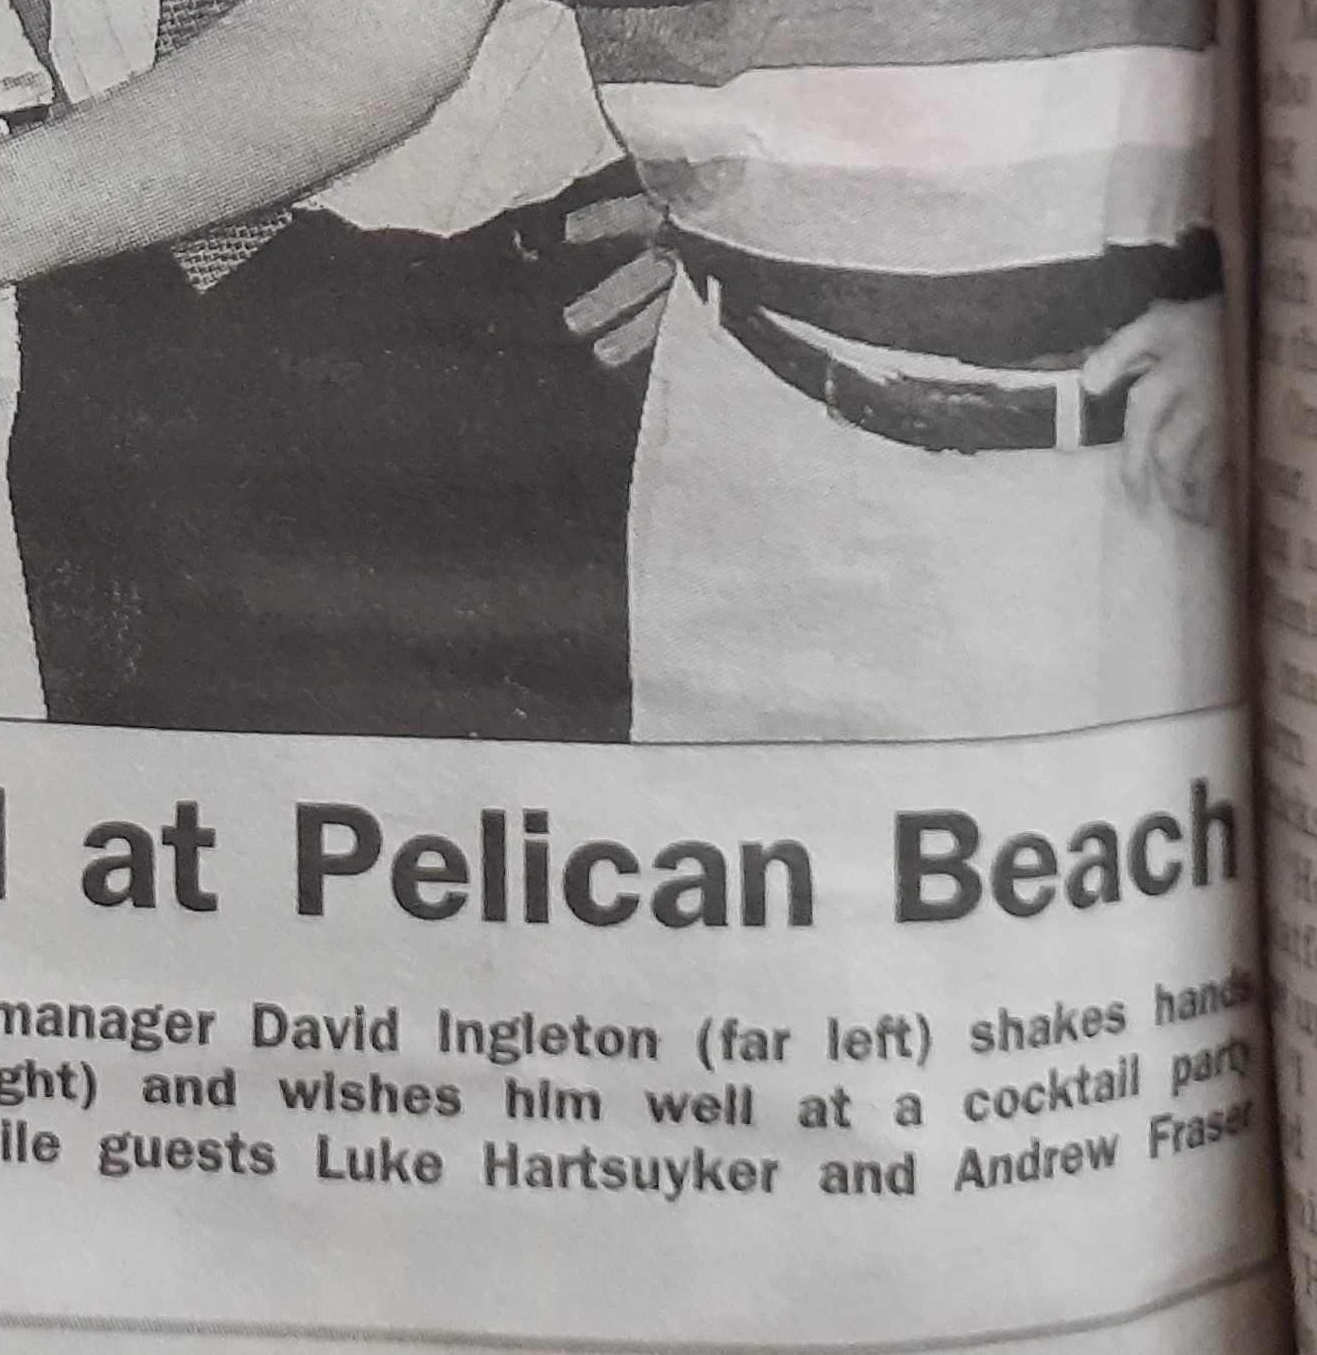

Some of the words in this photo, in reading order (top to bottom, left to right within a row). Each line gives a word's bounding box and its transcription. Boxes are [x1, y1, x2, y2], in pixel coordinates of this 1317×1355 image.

[81, 801, 219, 913] at
[295, 802, 814, 930] Pelican
[894, 779, 1238, 925] Beach
[252, 1002, 399, 1053] David
[439, 1009, 657, 1066] Ingleton
[696, 1018, 791, 1074] (far
[827, 1013, 933, 1068] left)
[971, 1001, 1127, 1055] shakes
[142, 1067, 236, 1108] and
[278, 1071, 461, 1117] wishes
[505, 1077, 601, 1121] him
[645, 1084, 752, 1126] well
[799, 1087, 852, 1129] at
[895, 1093, 923, 1127] a
[964, 1053, 1139, 1122] cocktail
[98, 1131, 277, 1178] guests
[317, 1133, 443, 1185] Luke
[483, 1141, 778, 1203] Hartsuyker
[820, 1153, 915, 1196] and
[955, 1134, 1118, 1191] Andrew
[1148, 1099, 1254, 1159] Fraser
